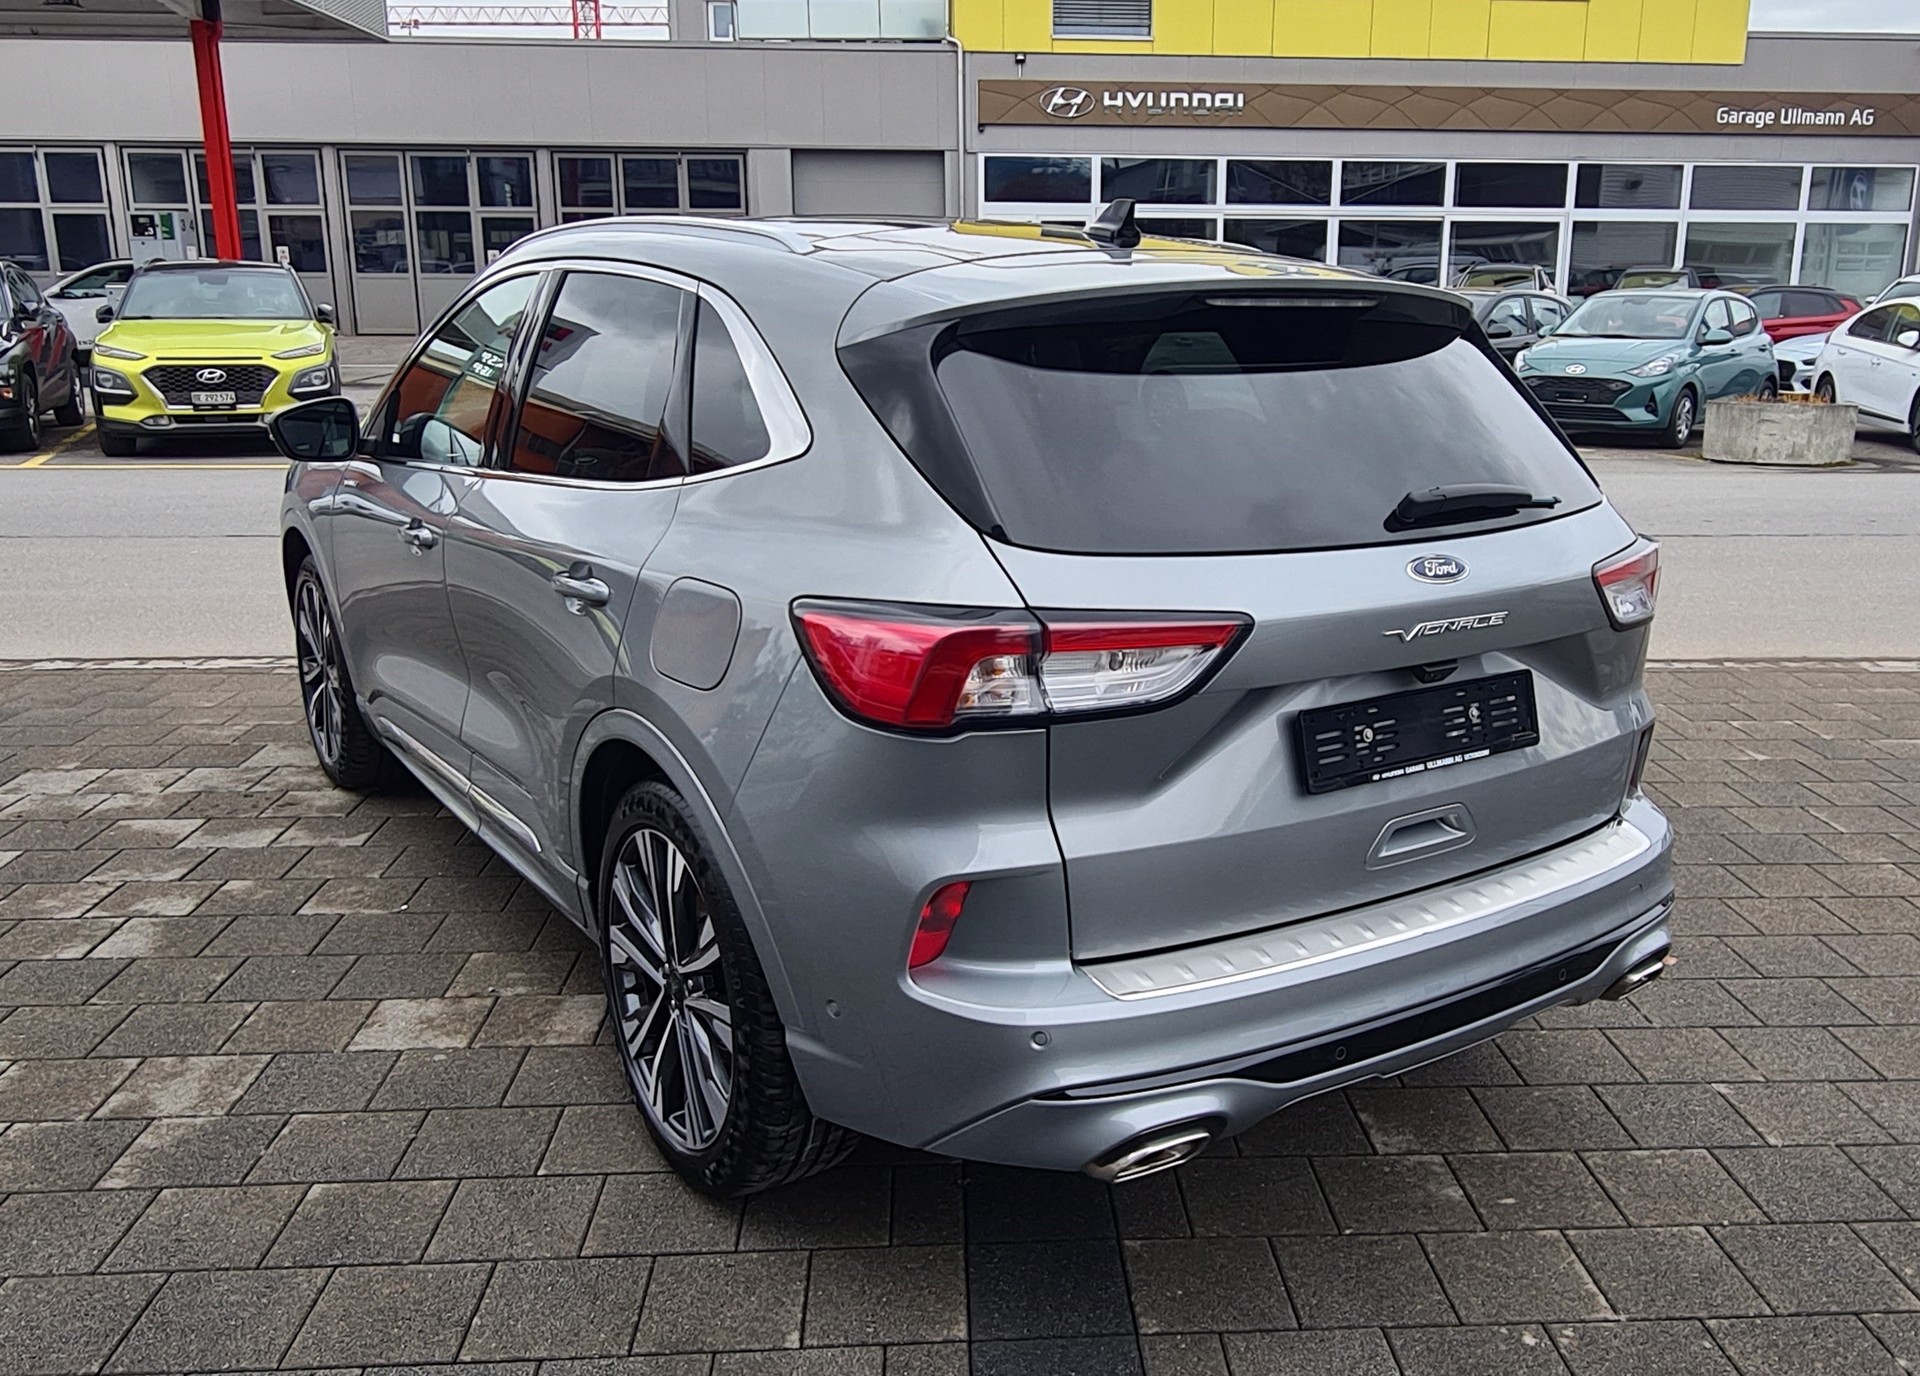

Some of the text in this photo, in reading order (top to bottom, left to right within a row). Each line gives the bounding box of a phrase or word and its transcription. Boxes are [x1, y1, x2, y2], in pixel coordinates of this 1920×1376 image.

[1103, 90, 1245, 116] HYUNDAI
[1716, 106, 1875, 128] Garage Ullmann AG
[1424, 558, 1459, 577] Ford
[1382, 610, 1509, 642] VIGNALE
